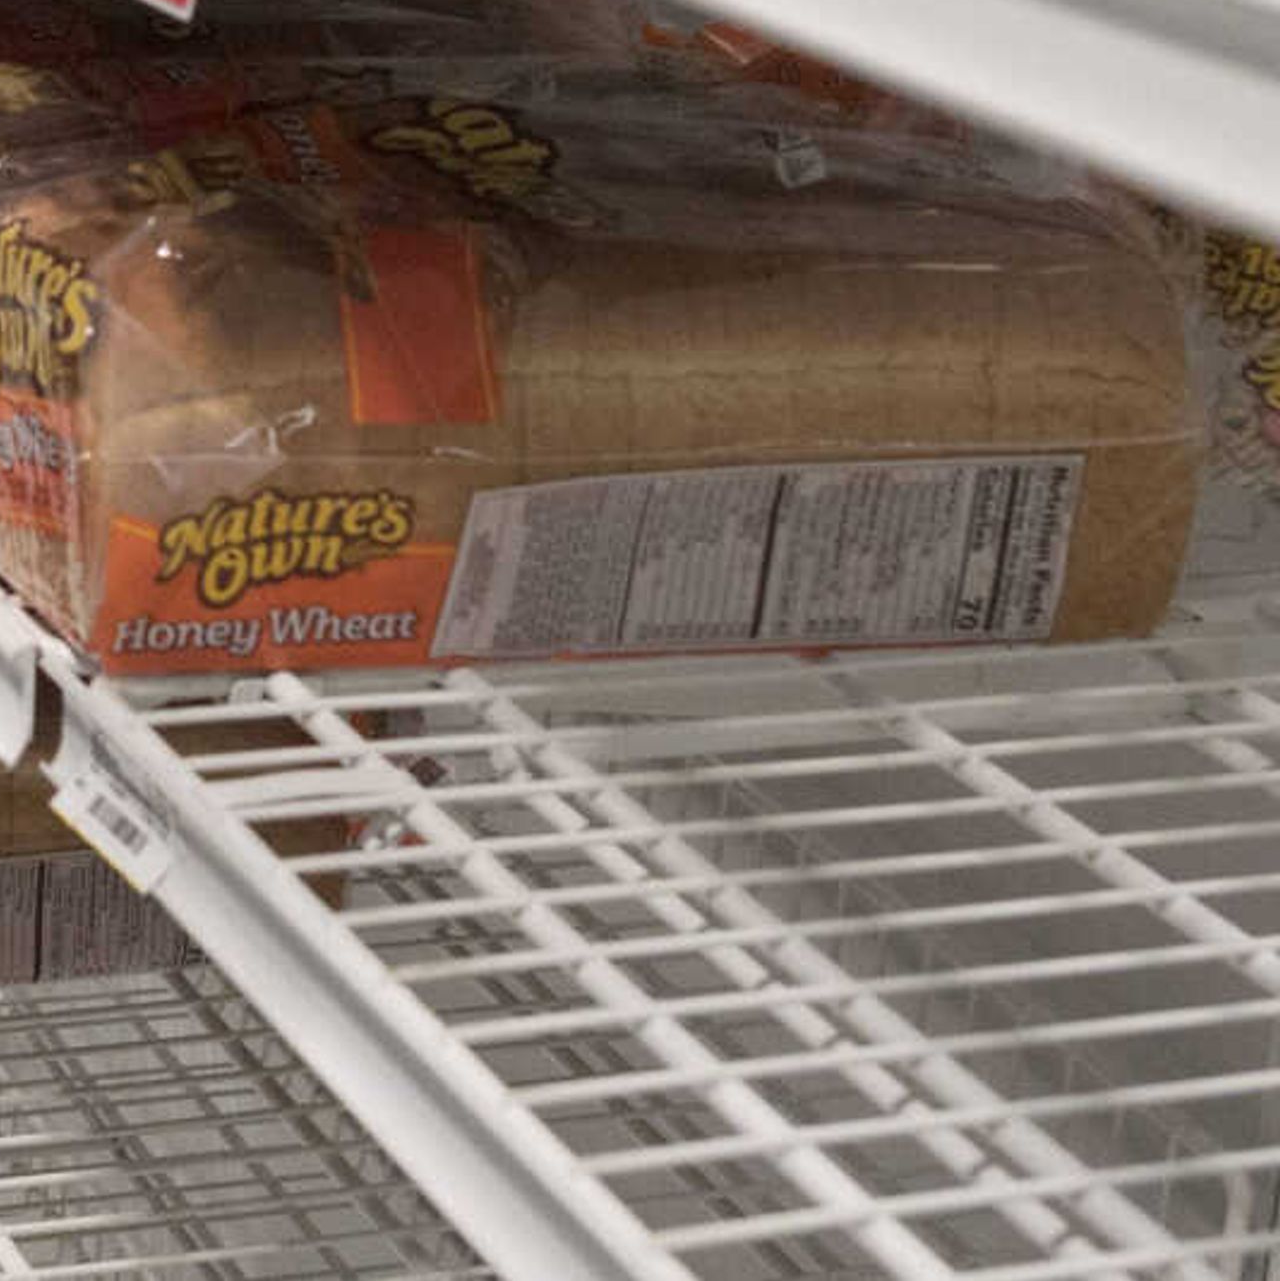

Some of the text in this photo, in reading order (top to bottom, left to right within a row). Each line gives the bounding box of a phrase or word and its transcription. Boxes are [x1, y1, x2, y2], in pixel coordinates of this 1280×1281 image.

[155, 488, 416, 584] Nature's
[199, 534, 344, 608] Own
[111, 606, 417, 657] Honey Wheat
